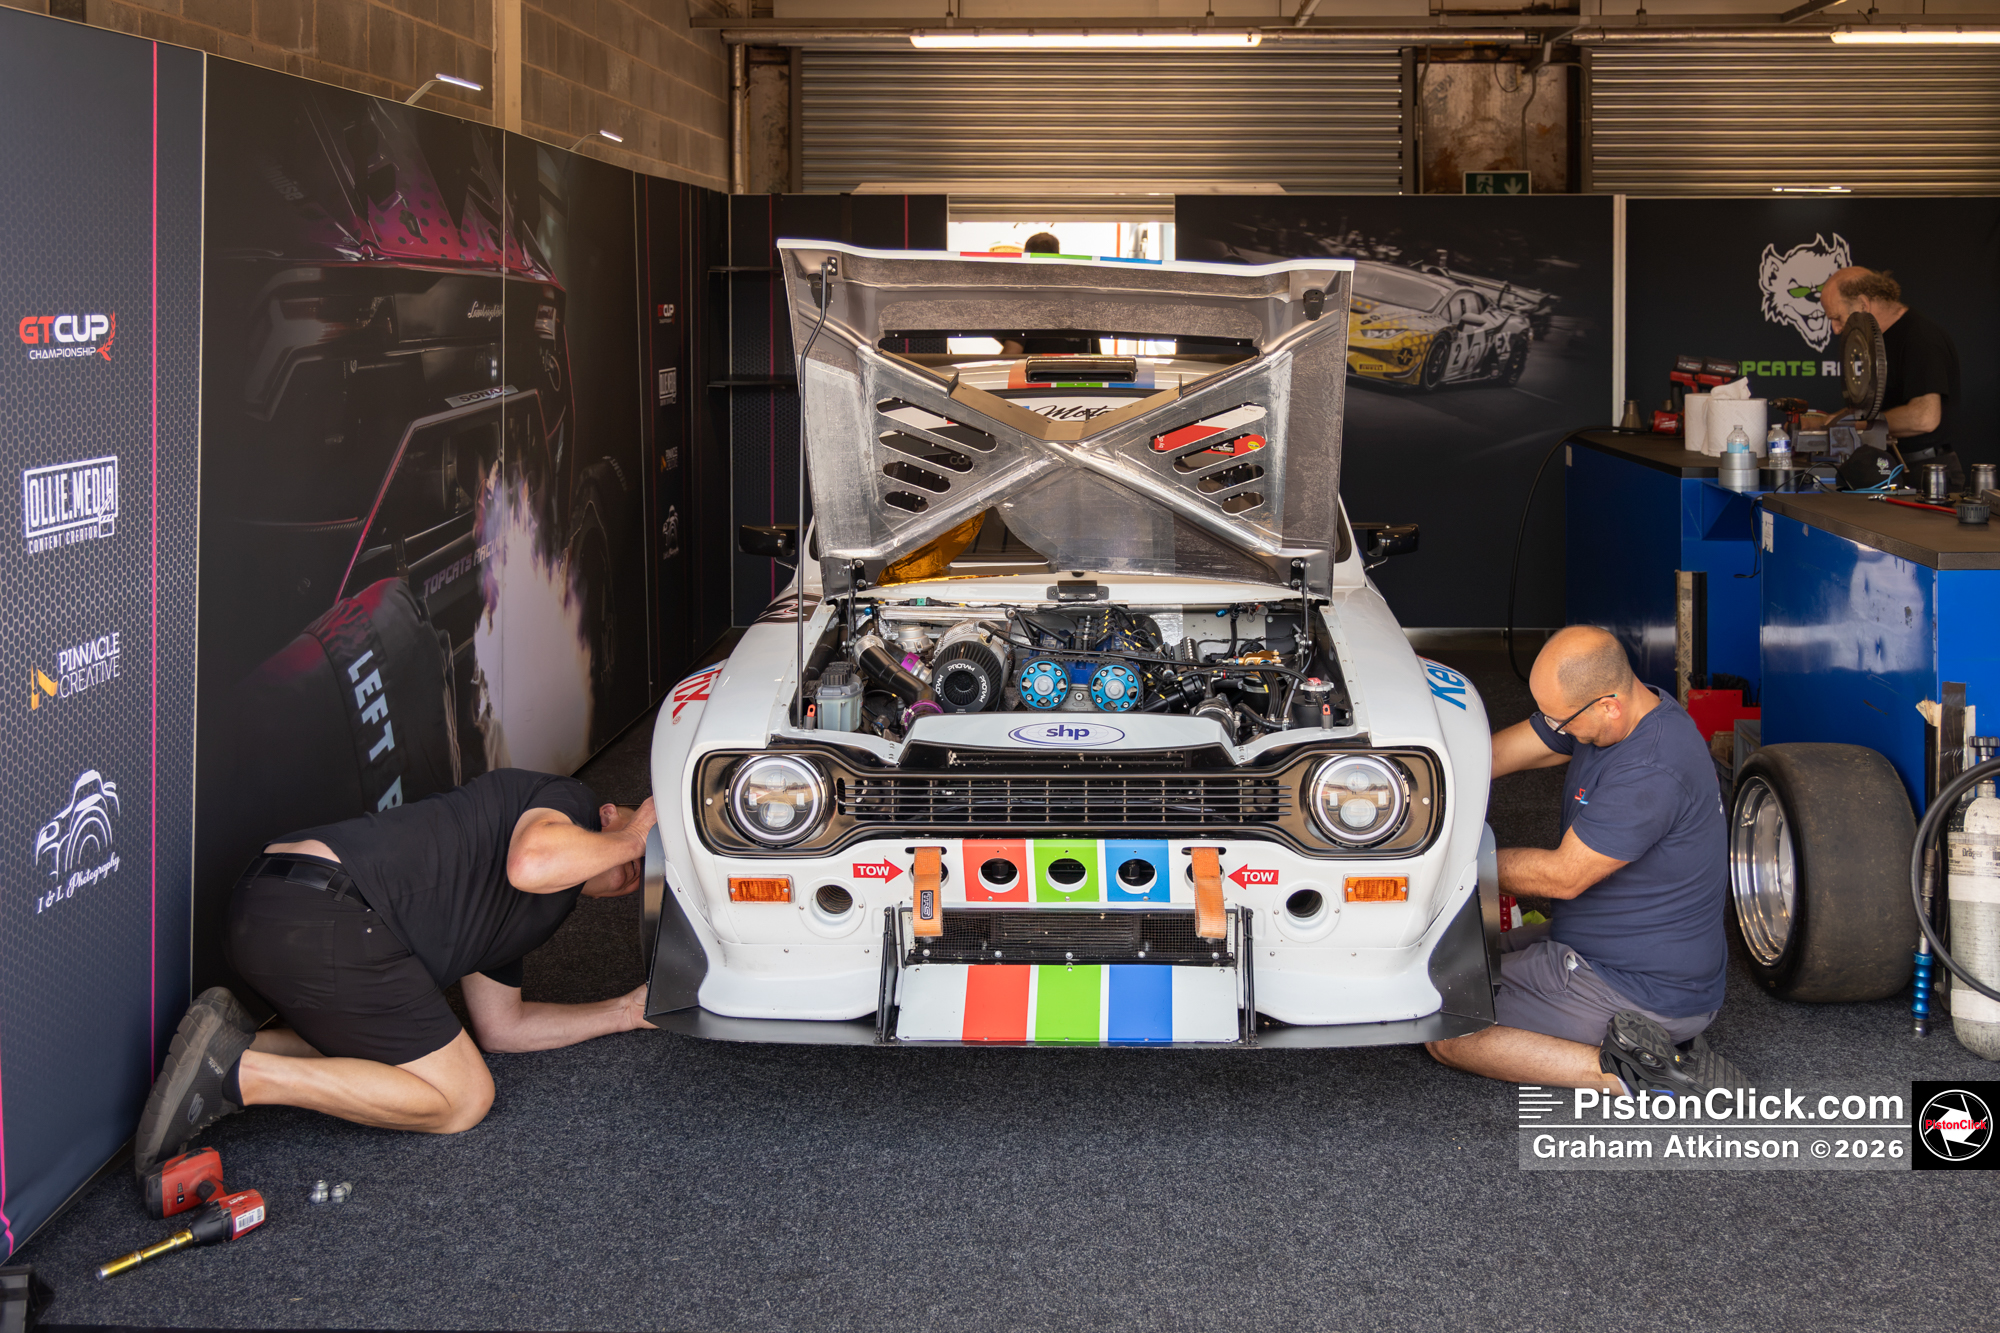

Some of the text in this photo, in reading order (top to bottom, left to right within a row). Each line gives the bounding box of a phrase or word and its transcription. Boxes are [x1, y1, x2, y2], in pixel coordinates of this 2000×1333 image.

[29, 347, 97, 360] CHAMPIONSHIP
[1738, 361, 1816, 376] PCATS
[28, 524, 98, 554] CONTENT CREATOR
[423, 552, 473, 598] TOPCATS
[59, 631, 120, 674] PINNACLE
[59, 655, 120, 698] CREATIVE
[347, 649, 396, 762] LEFT
[1046, 725, 1090, 740] shp
[66, 851, 120, 899] Photography
[857, 865, 890, 876] TOW
[1241, 871, 1274, 882] TOW
